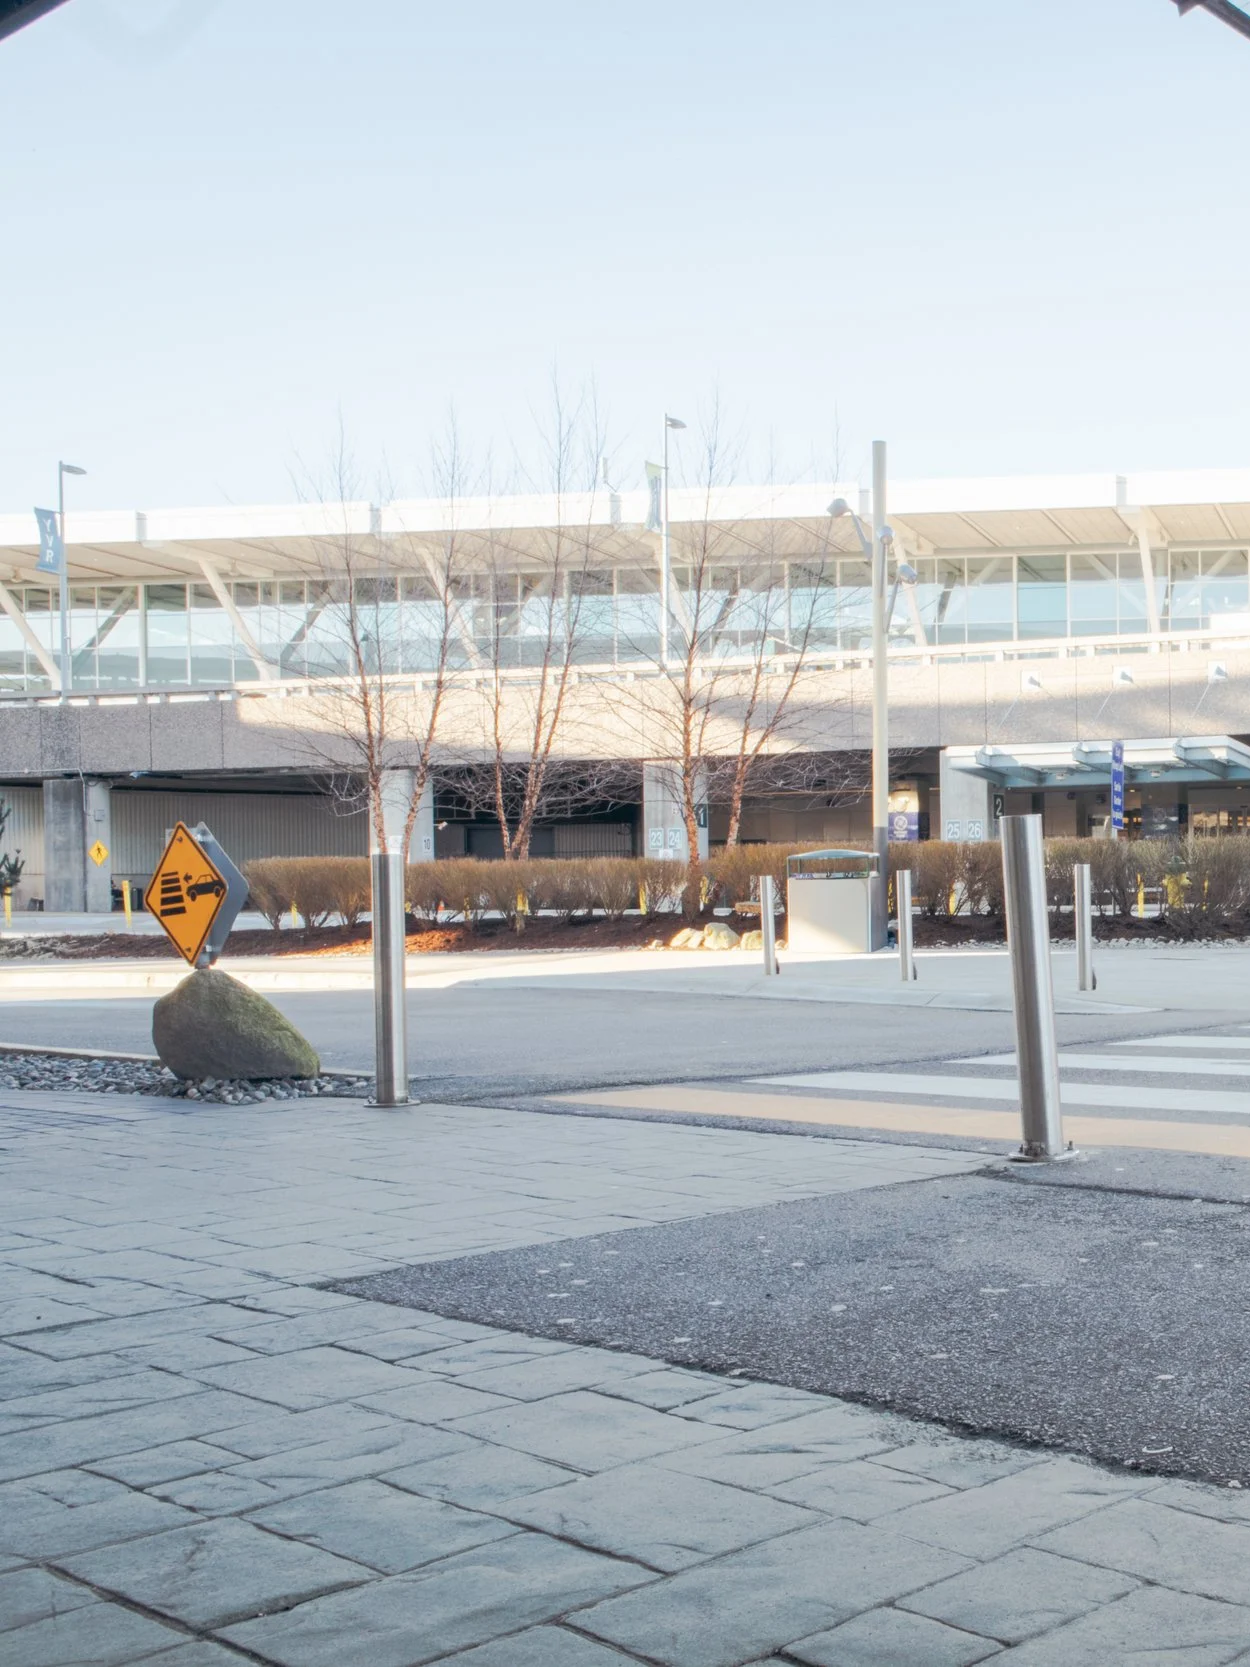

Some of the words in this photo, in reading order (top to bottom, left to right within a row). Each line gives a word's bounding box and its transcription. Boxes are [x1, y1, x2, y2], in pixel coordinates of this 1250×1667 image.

[43, 517, 54, 564] YVR
[996, 798, 1002, 815] 2
[948, 823, 960, 839] 25
[968, 822, 981, 838] 26
[651, 831, 662, 847] 23
[669, 831, 681, 847] 24
